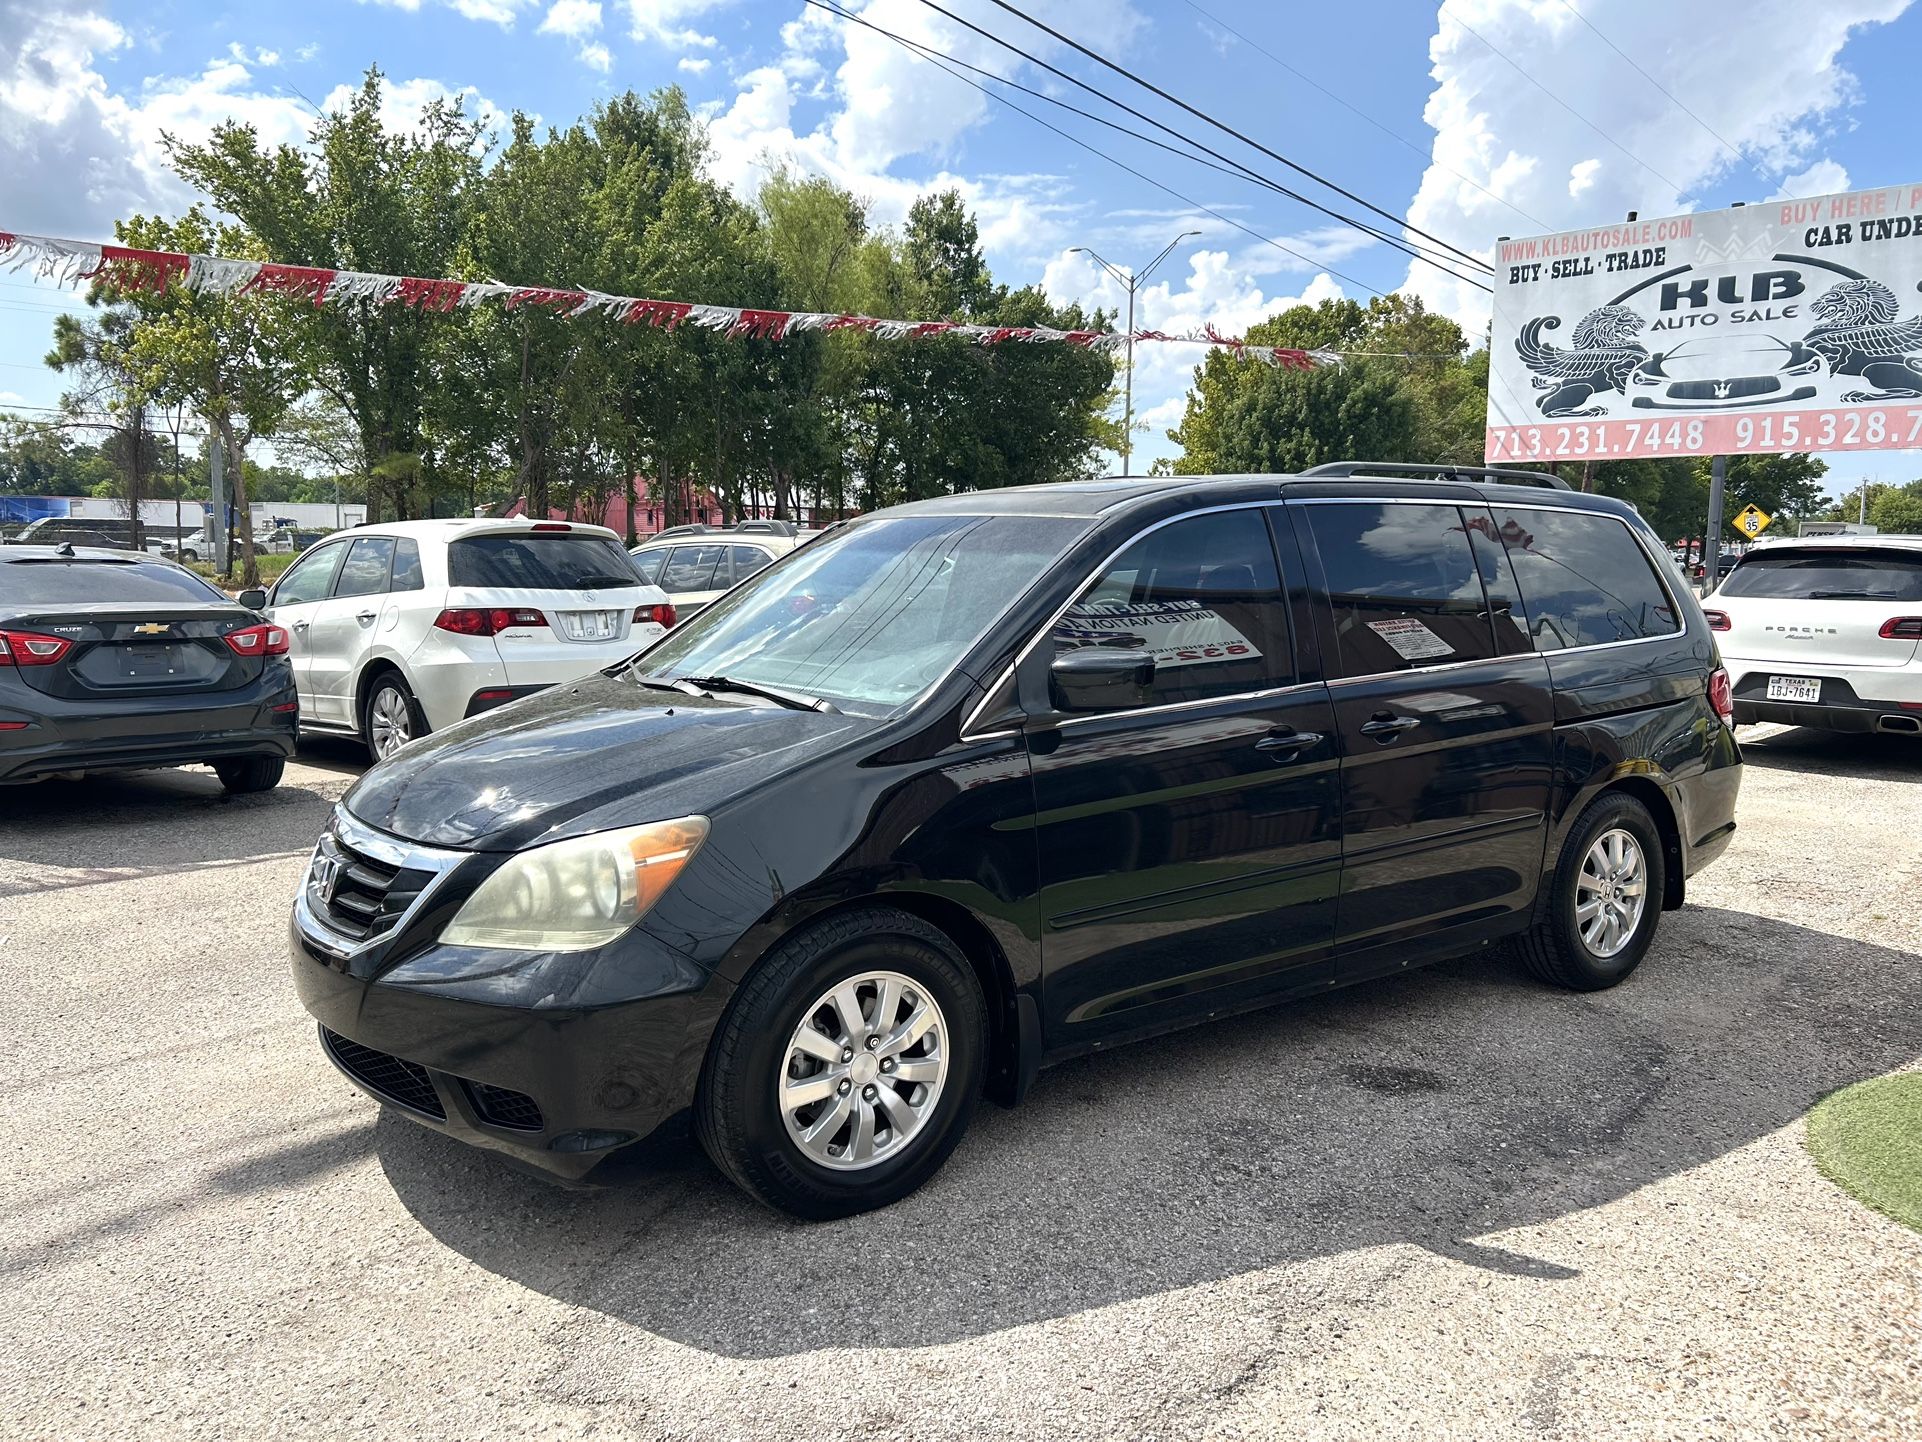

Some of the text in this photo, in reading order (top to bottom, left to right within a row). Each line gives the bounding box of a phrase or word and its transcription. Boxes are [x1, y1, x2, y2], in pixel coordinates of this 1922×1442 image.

[1780, 202, 1821, 225] BUY
[1831, 192, 1887, 219] HERE
[1501, 218, 1693, 263] WWW.KLBAUTOSALE.COM
[1804, 214, 1922, 248] CAR UNDE
[1509, 246, 1666, 285] BUY SELL TRADE
[1660, 270, 1806, 312] KLB
[1650, 304, 1799, 332] AUTO SALE
[1491, 409, 1922, 458] 713.231.7448 915.328.7
[1746, 521, 1758, 531] 35
